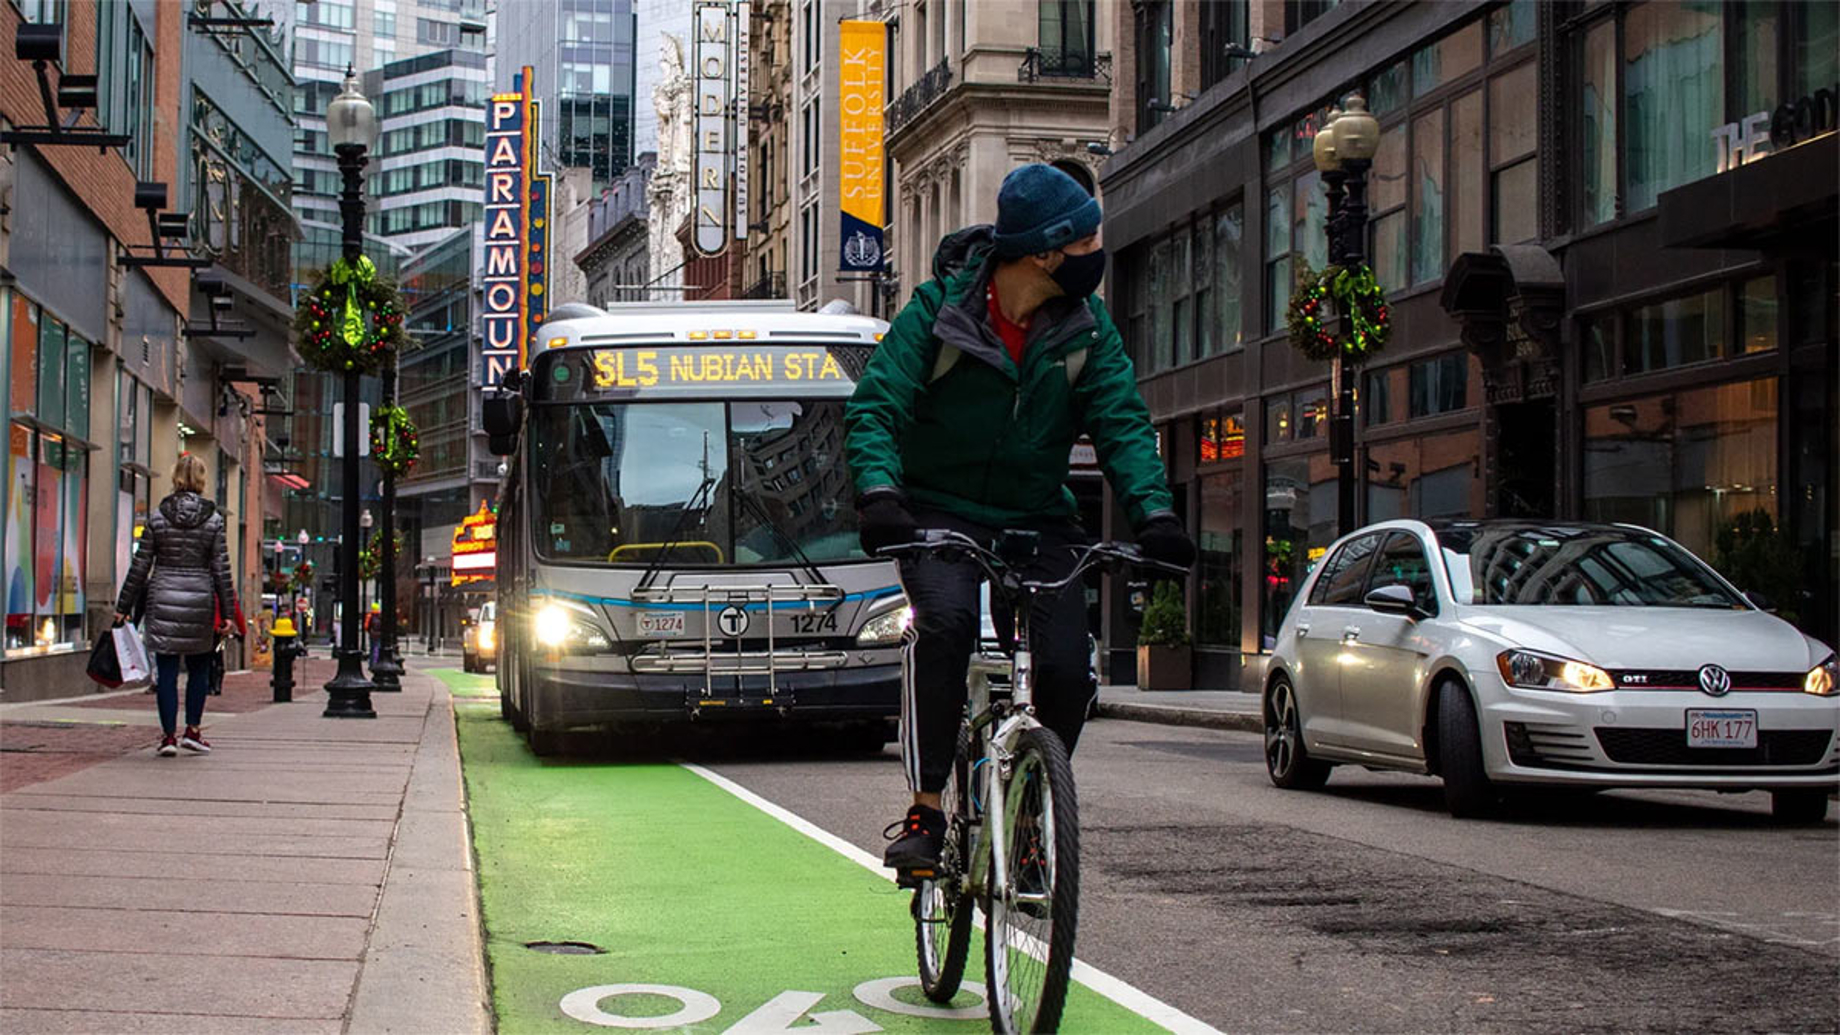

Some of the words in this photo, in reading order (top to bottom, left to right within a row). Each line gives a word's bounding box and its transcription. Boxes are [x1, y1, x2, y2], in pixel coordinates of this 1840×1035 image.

[739, 31, 748, 126] UNIVERSITY
[702, 20, 726, 228] MODERN
[844, 48, 867, 200] SUFFOLK
[866, 47, 882, 198] UNIVERSITY
[1711, 111, 1769, 174] THE
[1771, 84, 1839, 150] GOD
[738, 144, 747, 215] SUFFOLK
[487, 102, 518, 385] PARAMOUN
[594, 351, 659, 387] SL5
[670, 354, 773, 381] NUBIAN
[784, 353, 841, 380] STA
[655, 618, 683, 631] 1274
[790, 613, 838, 633] 1274
[1622, 675, 1648, 684] GTI
[1691, 719, 1720, 739] 6HK
[1725, 720, 1753, 739] 177
